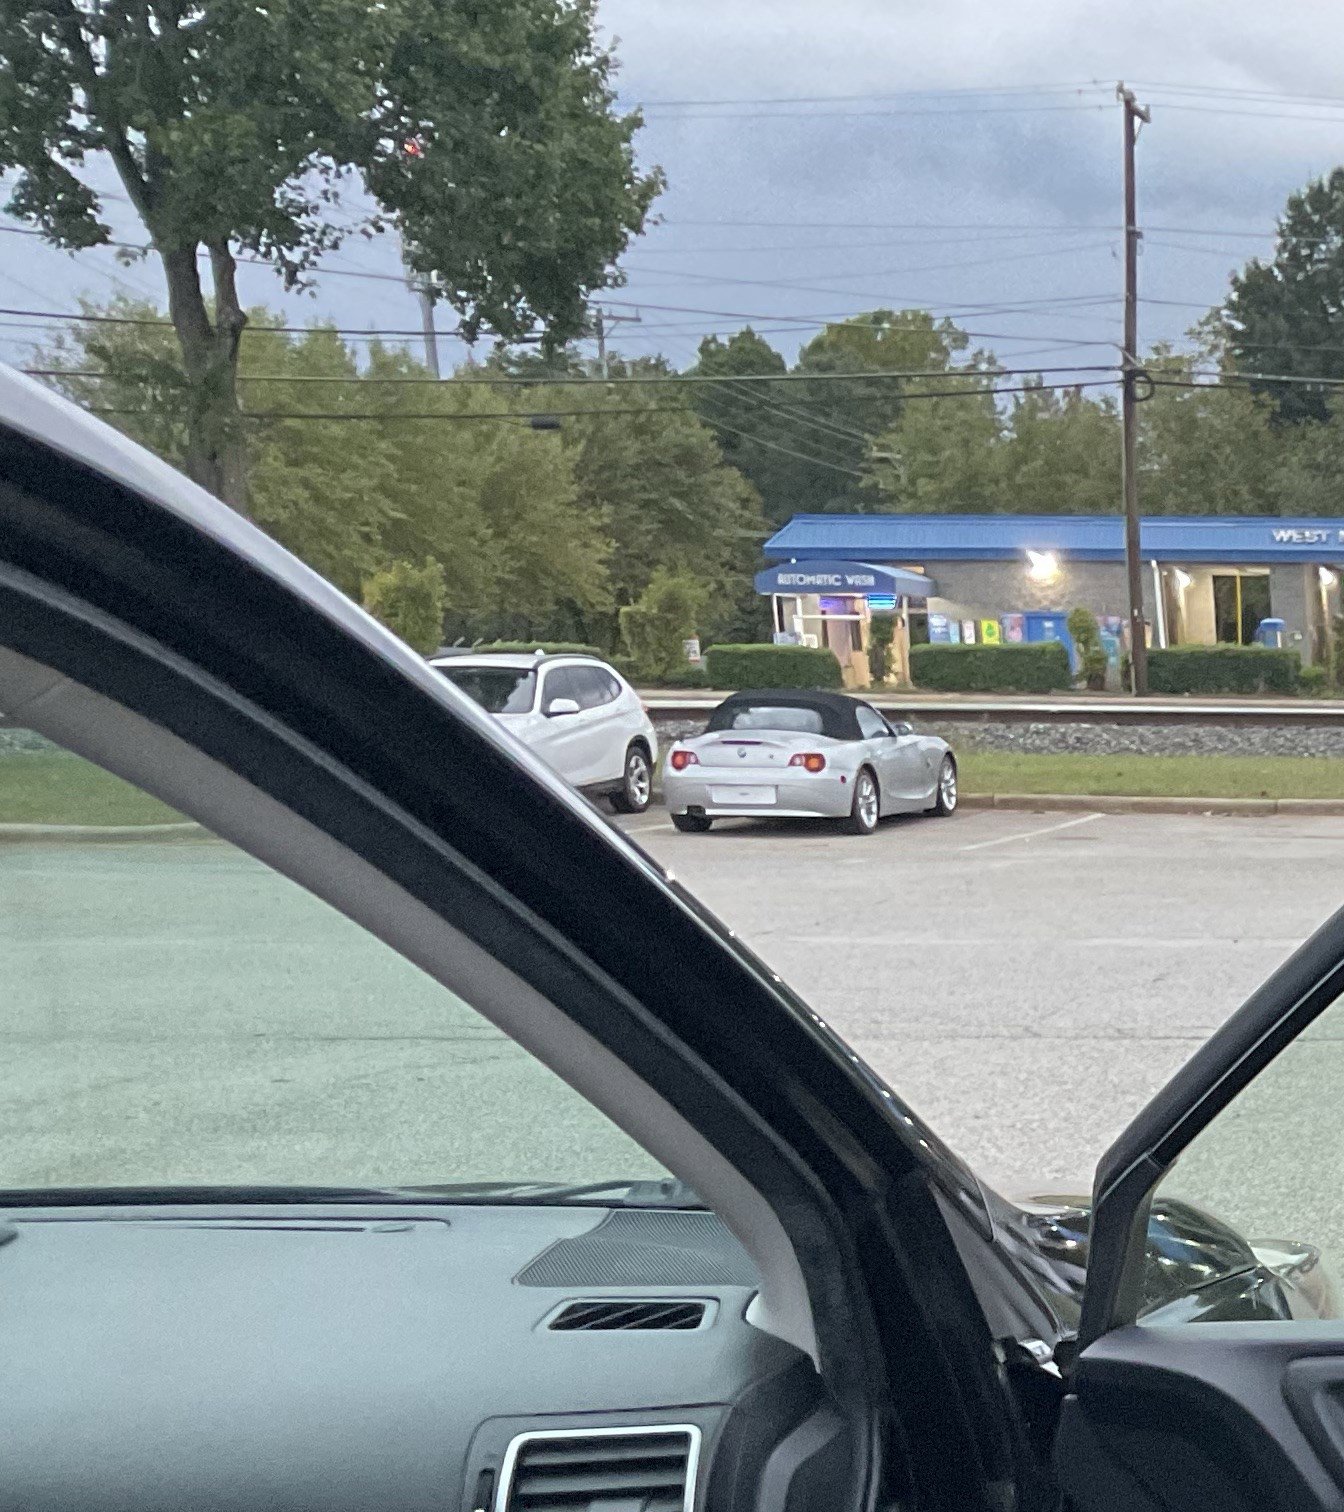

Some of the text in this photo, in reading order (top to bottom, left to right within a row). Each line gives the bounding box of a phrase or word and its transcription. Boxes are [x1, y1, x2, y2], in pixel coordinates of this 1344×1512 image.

[1272, 528, 1330, 545] WEST
[777, 573, 875, 587] AUTOMATIC WASH
